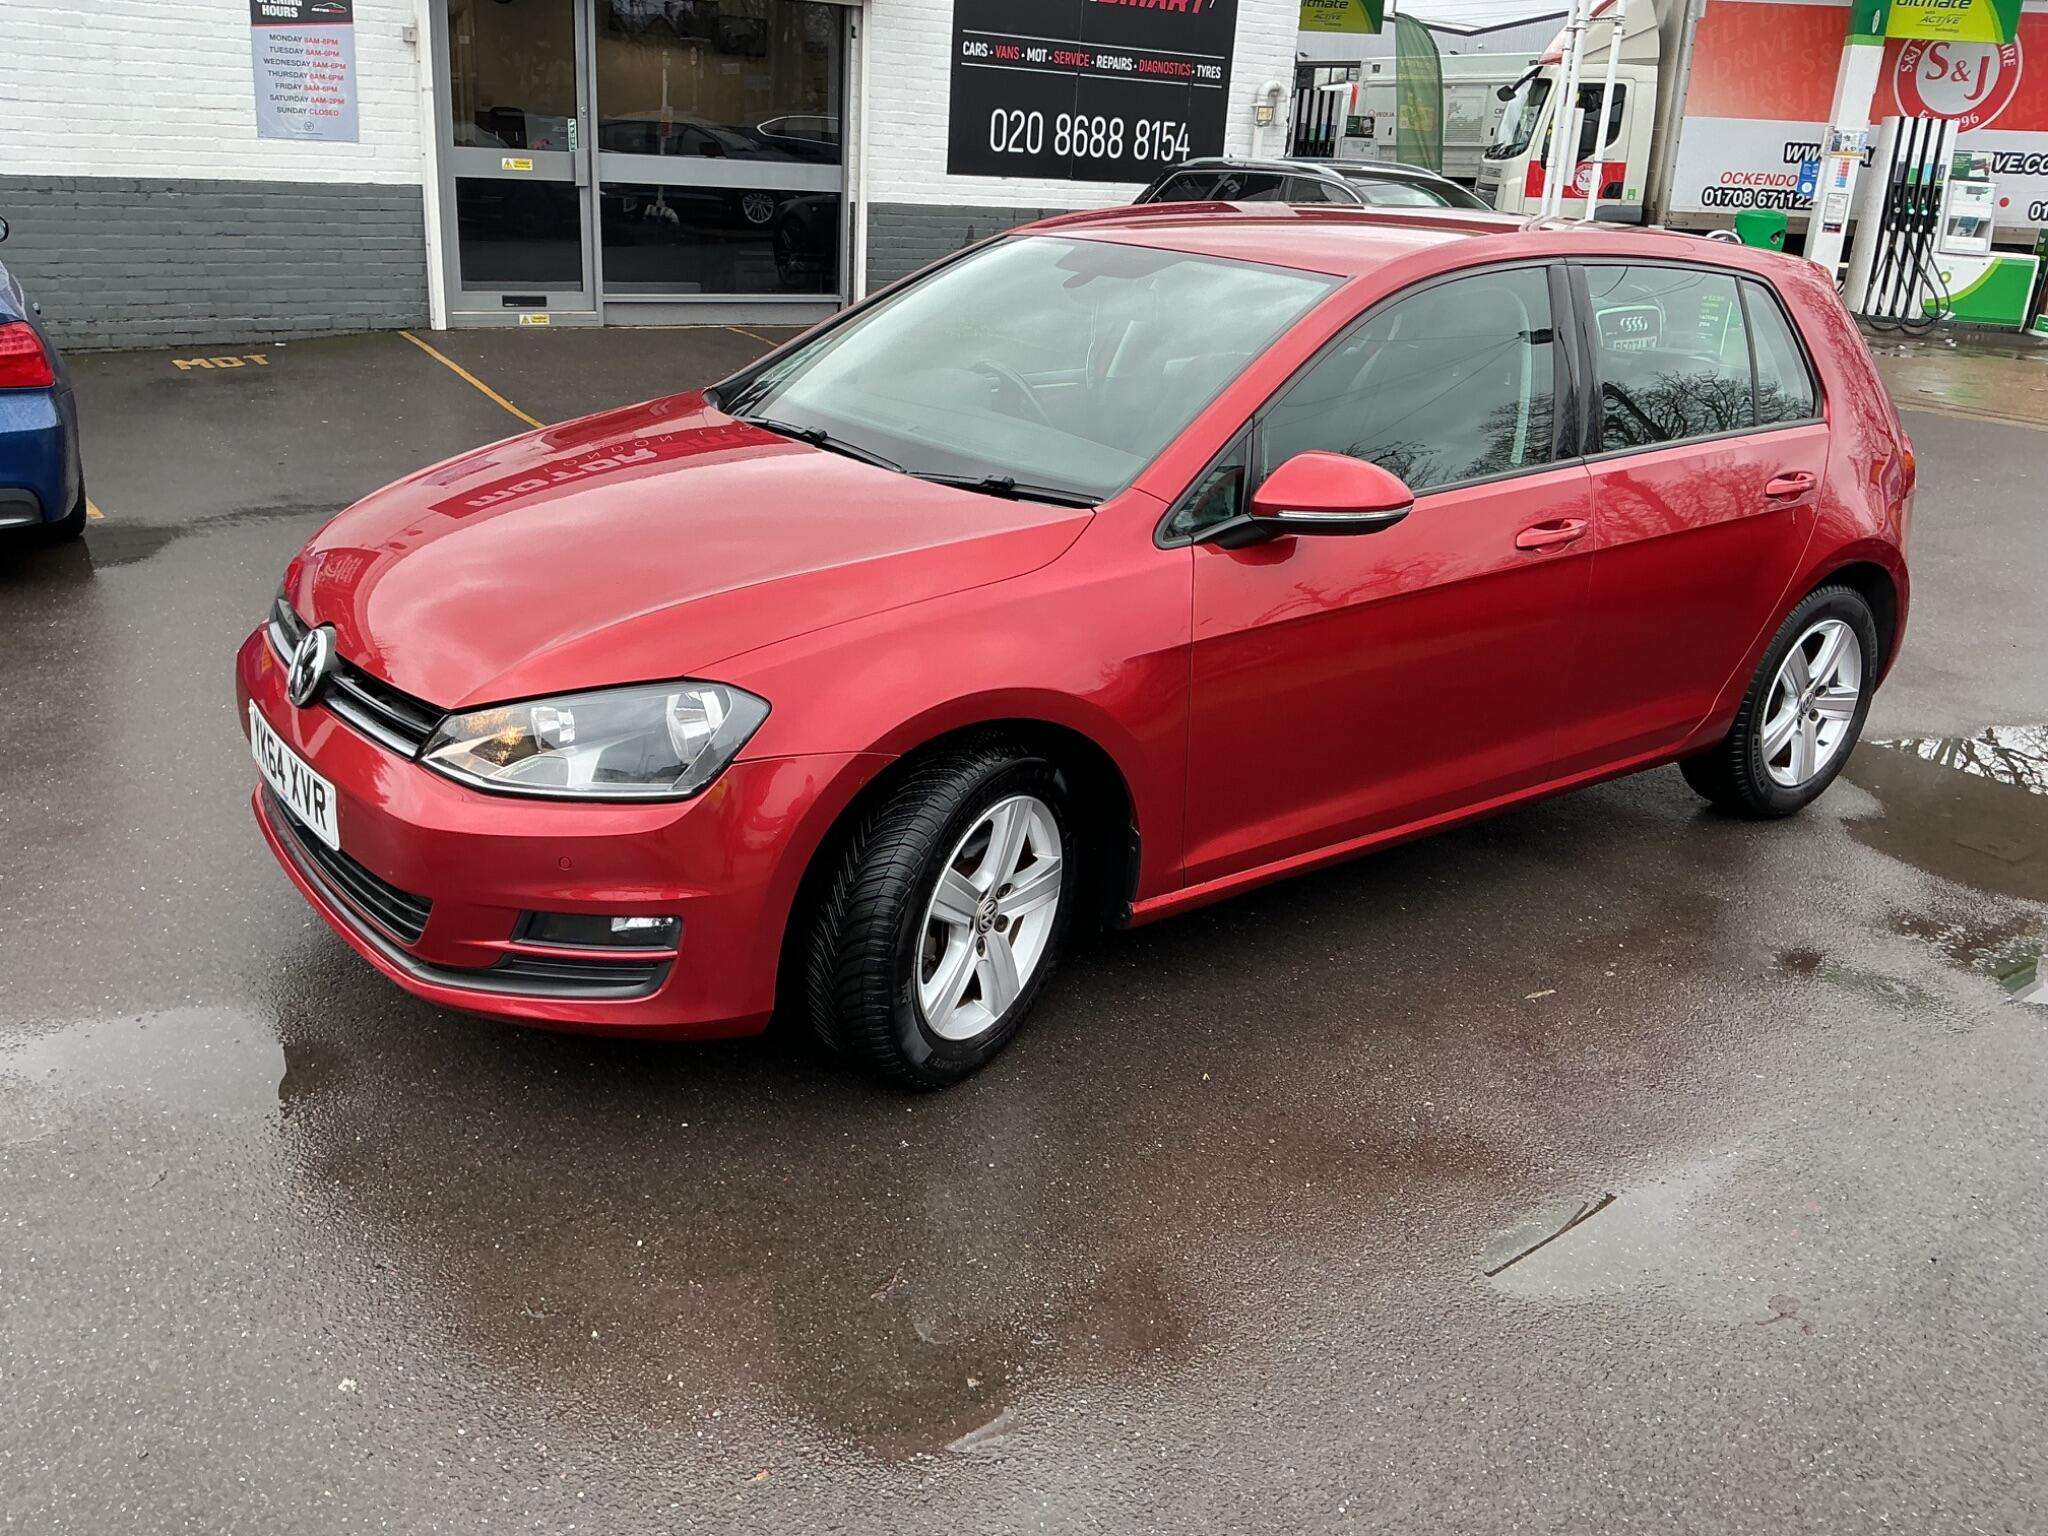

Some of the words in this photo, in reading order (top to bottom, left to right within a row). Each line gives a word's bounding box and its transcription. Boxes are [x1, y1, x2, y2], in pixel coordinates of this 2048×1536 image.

[262, 5, 298, 18] HOURS
[269, 34, 302, 43] MONDAY
[269, 46, 304, 55] TUESDAY
[2001, 43, 2017, 68] IRE
[264, 58, 311, 67] WEDNESDAY
[963, 40, 988, 57] CARS
[995, 45, 1020, 61] VANS
[1026, 47, 1048, 63] MOT
[1053, 50, 1090, 68] SERVICE
[1096, 55, 1133, 71] REPAIRS
[1138, 59, 1191, 76] DIAGNOSTICS
[1196, 64, 1222, 80] TYRES
[268, 70, 308, 79] THURSDAY
[1925, 42, 1990, 101] S&J
[275, 82, 302, 91] FRIDAY
[269, 94, 309, 103] SATURDAY
[276, 106, 307, 115] SUNDAY
[309, 108, 340, 117] CLOSED
[990, 108, 1044, 154] 020
[1054, 112, 1125, 159] 8688
[1133, 118, 1191, 161] 8154
[1720, 172, 1798, 188] OCKENDO
[1703, 188, 1755, 207] 01708
[171, 354, 269, 370] MOT
[253, 711, 286, 790] YK64
[288, 754, 328, 831] XVR
